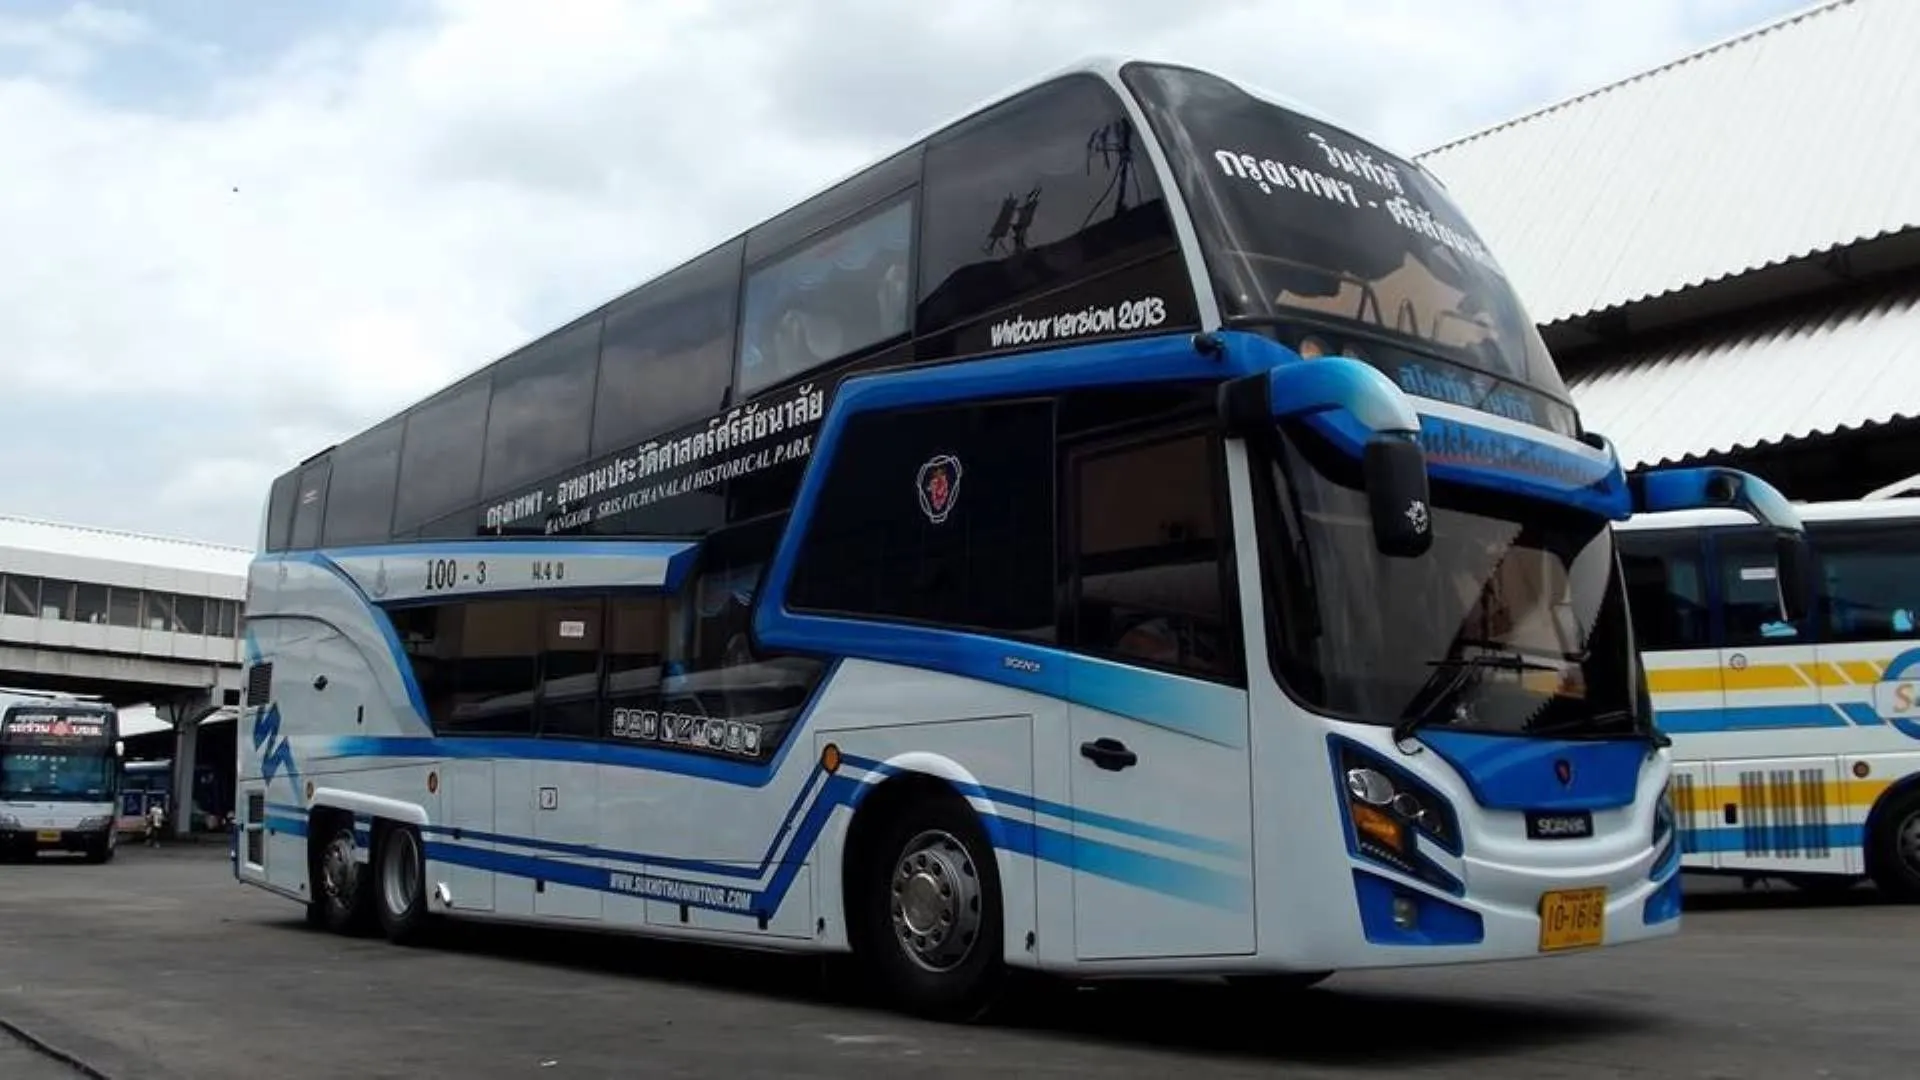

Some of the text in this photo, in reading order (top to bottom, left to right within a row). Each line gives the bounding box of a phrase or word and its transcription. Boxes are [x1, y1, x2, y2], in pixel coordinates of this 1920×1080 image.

[1118, 297, 1167, 330] 2013
[693, 450, 771, 490] HISTORICAL
[774, 435, 814, 466] PARK
[425, 559, 457, 590] 100
[477, 560, 487, 585] 3
